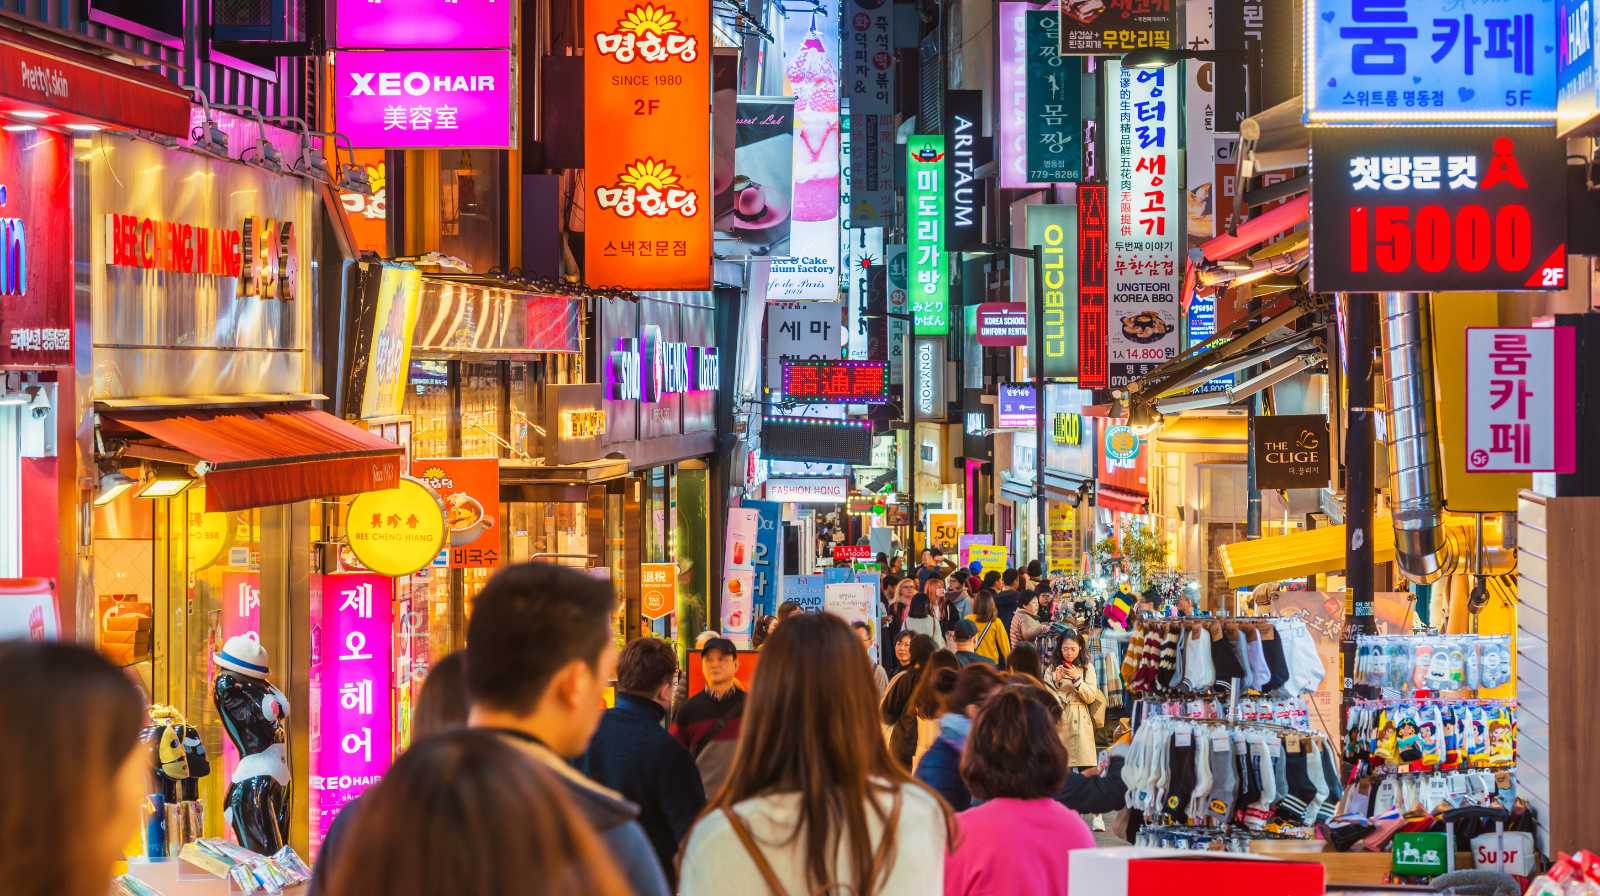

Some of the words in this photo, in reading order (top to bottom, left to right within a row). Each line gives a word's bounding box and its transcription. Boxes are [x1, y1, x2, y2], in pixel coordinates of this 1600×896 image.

[596, 31, 698, 63] 명화당
[1103, 30, 1170, 49] 무한리필
[1431, 13, 1534, 76] 카페
[350, 72, 431, 97] XEO
[433, 75, 495, 92] HAIR
[612, 75, 650, 87] SINCE
[655, 75, 682, 86] 1980
[1342, 90, 1399, 107] 스위트룸
[1403, 90, 1444, 107] 명동점
[1505, 90, 1533, 106] 5F
[634, 100, 660, 116] 2F
[1134, 66, 1166, 150] 엉터리
[383, 104, 459, 131] 美容室
[954, 115, 973, 227] ARITAUM
[1031, 170, 1078, 179] 779-8286
[1350, 156, 1441, 190] 첫방문
[1447, 156, 1478, 190] 컷
[596, 185, 698, 217] 명화당
[1135, 154, 1166, 237] 생고기
[917, 170, 939, 294] 미도리가방
[1350, 205, 1532, 273] 15000
[113, 214, 139, 268] BEE
[142, 218, 192, 273] CHENG
[197, 227, 240, 277] HIANG
[603, 240, 687, 257] 스낵전문점
[1114, 241, 1143, 252] 두번째
[1145, 241, 1173, 252] 이야기
[797, 264, 835, 274] factory
[801, 256, 828, 265] Cake
[1541, 268, 1563, 287] 2F
[1044, 223, 1064, 358] CLUBCLIO
[1116, 282, 1171, 292] UNGTEORI
[912, 301, 944, 313] みどり
[1113, 294, 1149, 303] KOREA
[1151, 294, 1174, 303] BBQ
[913, 315, 944, 327] かばん
[984, 317, 1004, 325] KOREA
[1004, 317, 1025, 325] SCHOOL
[981, 327, 1007, 336] UNIFORM
[662, 341, 688, 393] VENUS
[920, 345, 932, 413] TONYMOLY
[1488, 334, 1534, 464] 룸카페
[1264, 440, 1288, 451] THE
[1265, 451, 1319, 464] CLIGE
[1472, 452, 1489, 466] 5F
[771, 485, 812, 495] FASHION
[814, 485, 841, 495] HONG
[356, 532, 369, 540] BEE
[371, 532, 402, 541] CHENG
[404, 533, 433, 542] HIANG
[339, 583, 374, 763] 제오헤어
